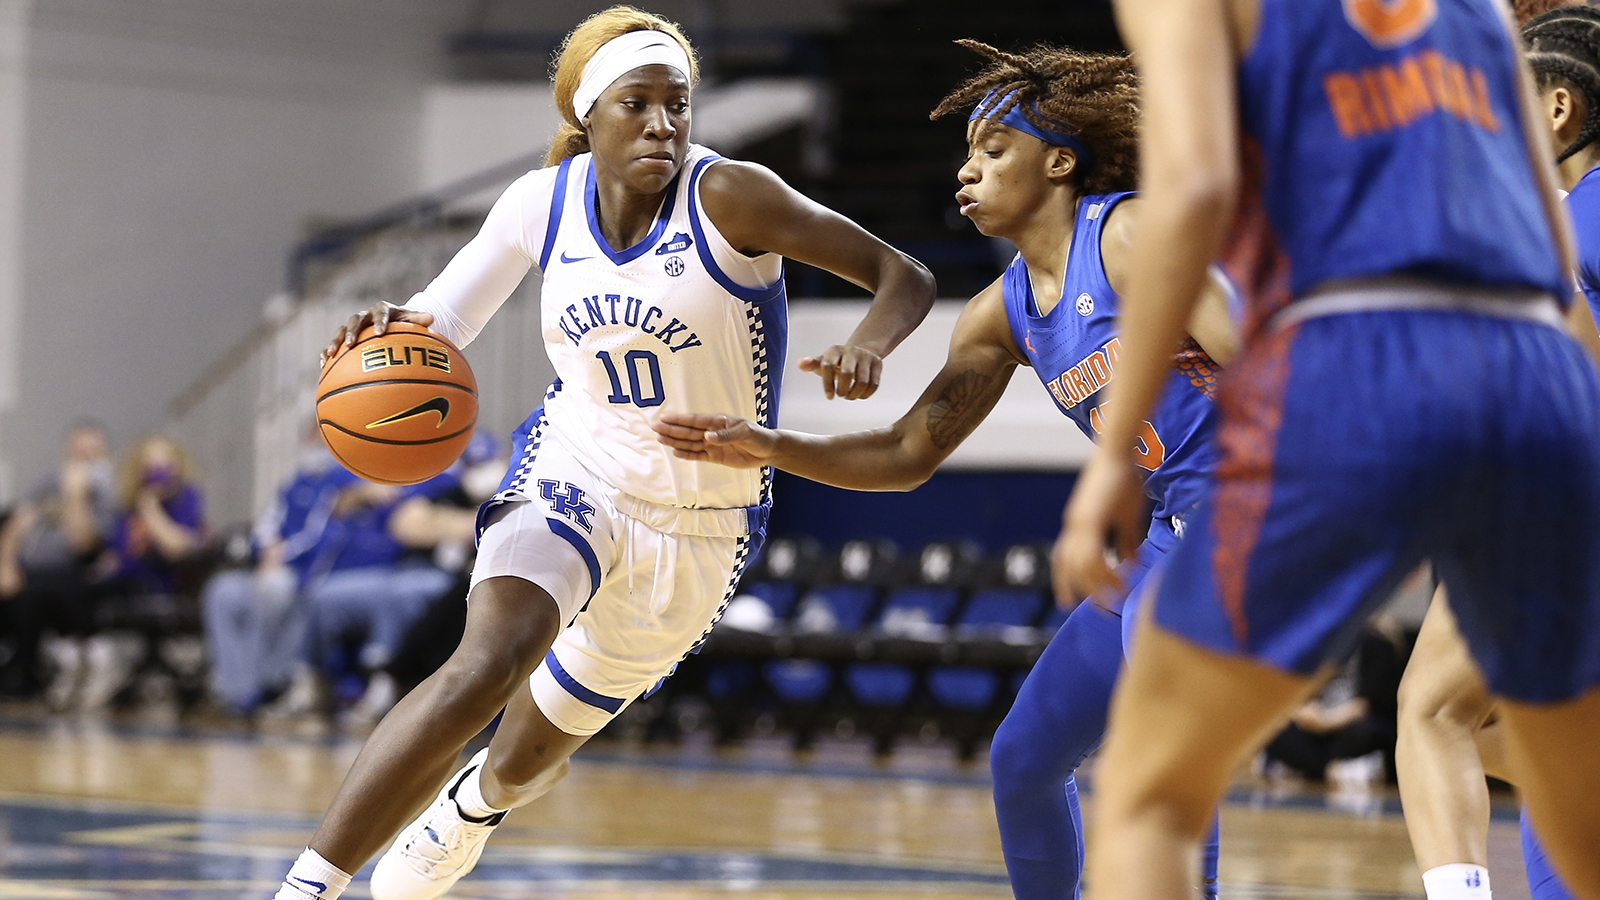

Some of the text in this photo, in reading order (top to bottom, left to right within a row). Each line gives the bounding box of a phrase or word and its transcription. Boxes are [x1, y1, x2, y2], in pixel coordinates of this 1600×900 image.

[664, 256, 685, 276] SEC
[559, 294, 702, 353] KENTUCKY
[361, 345, 451, 373] ELITE
[595, 350, 665, 408] 10
[537, 478, 596, 535] UK
